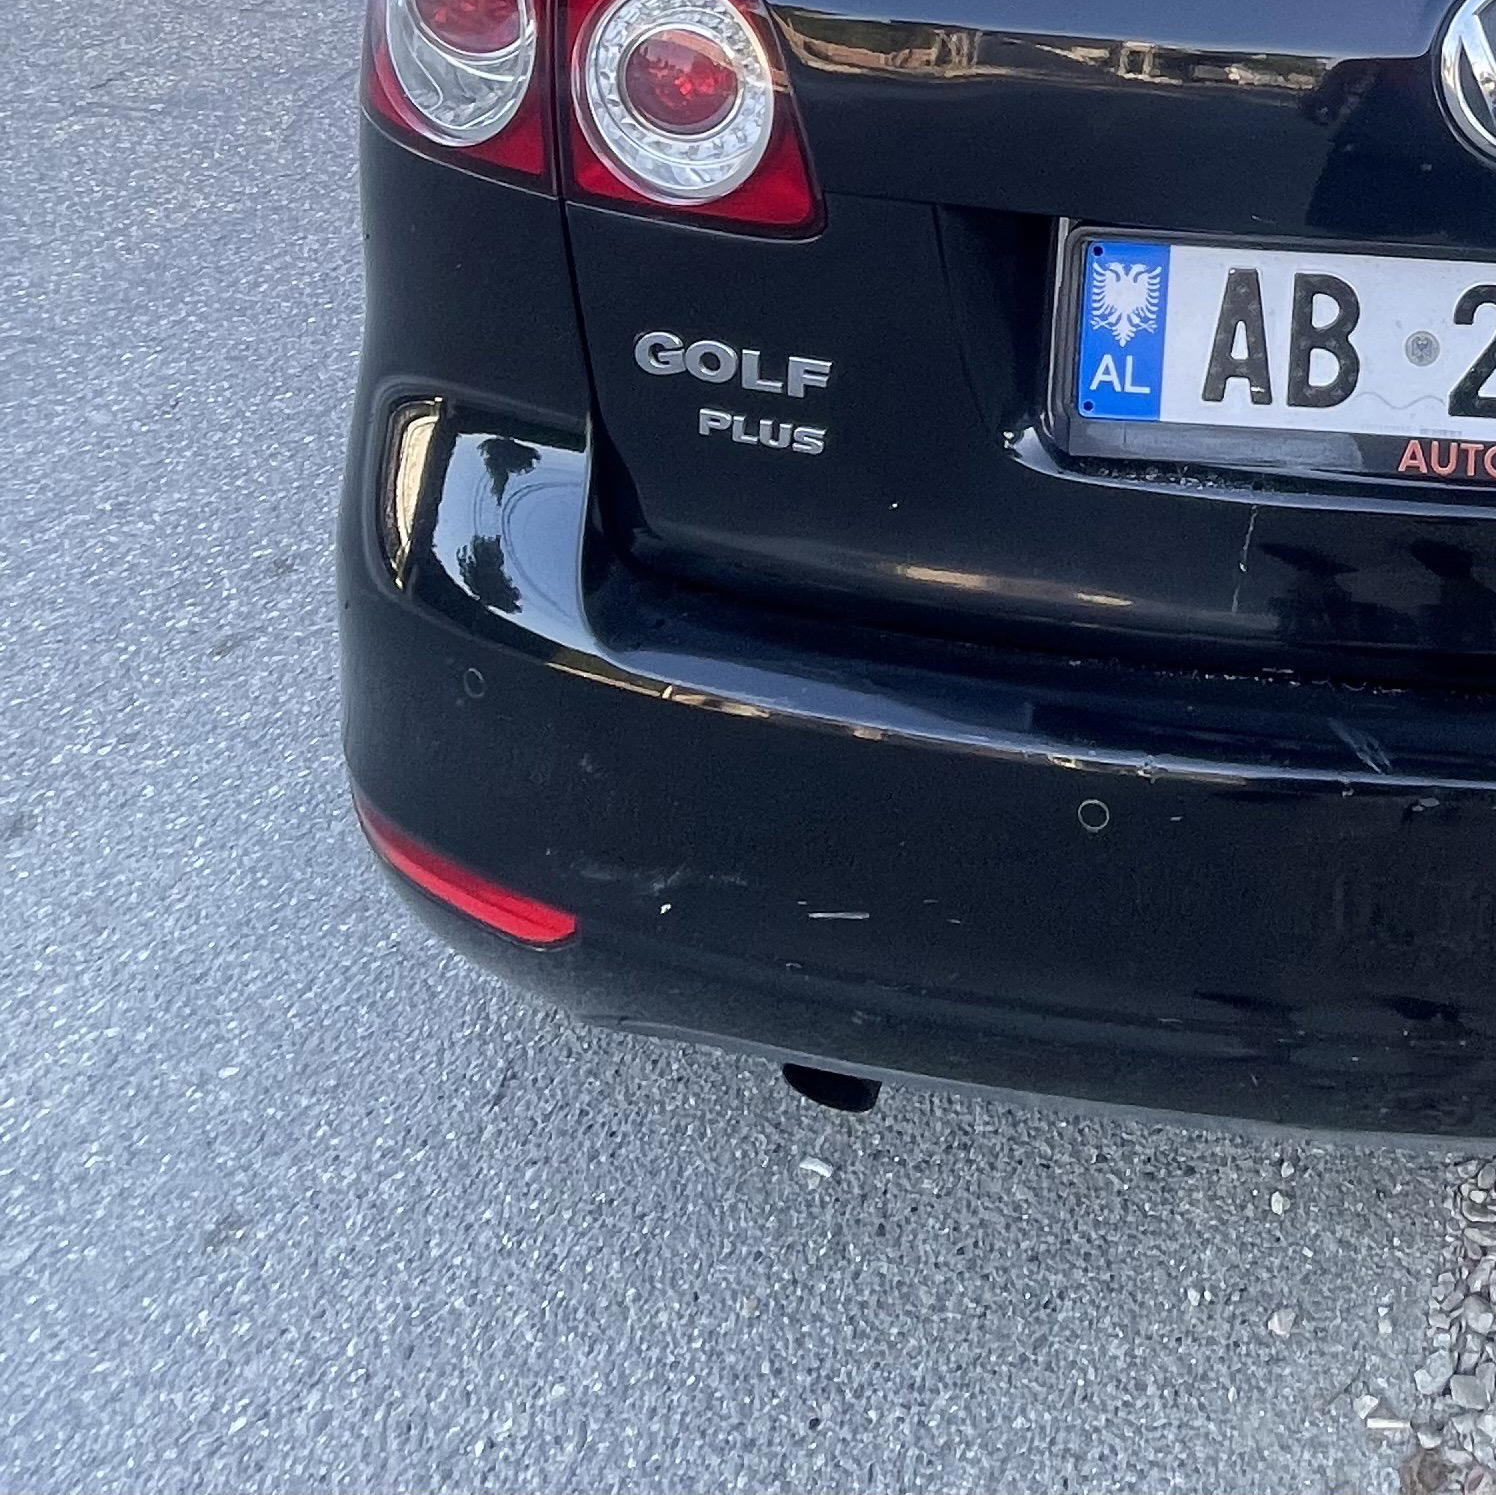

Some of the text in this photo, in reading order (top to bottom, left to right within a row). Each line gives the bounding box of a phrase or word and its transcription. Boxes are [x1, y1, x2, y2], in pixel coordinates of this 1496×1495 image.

[633, 331, 833, 399] GOLF
[1201, 266, 1362, 409] AB
[1088, 353, 1152, 395] AL
[698, 407, 828, 455] PLUS
